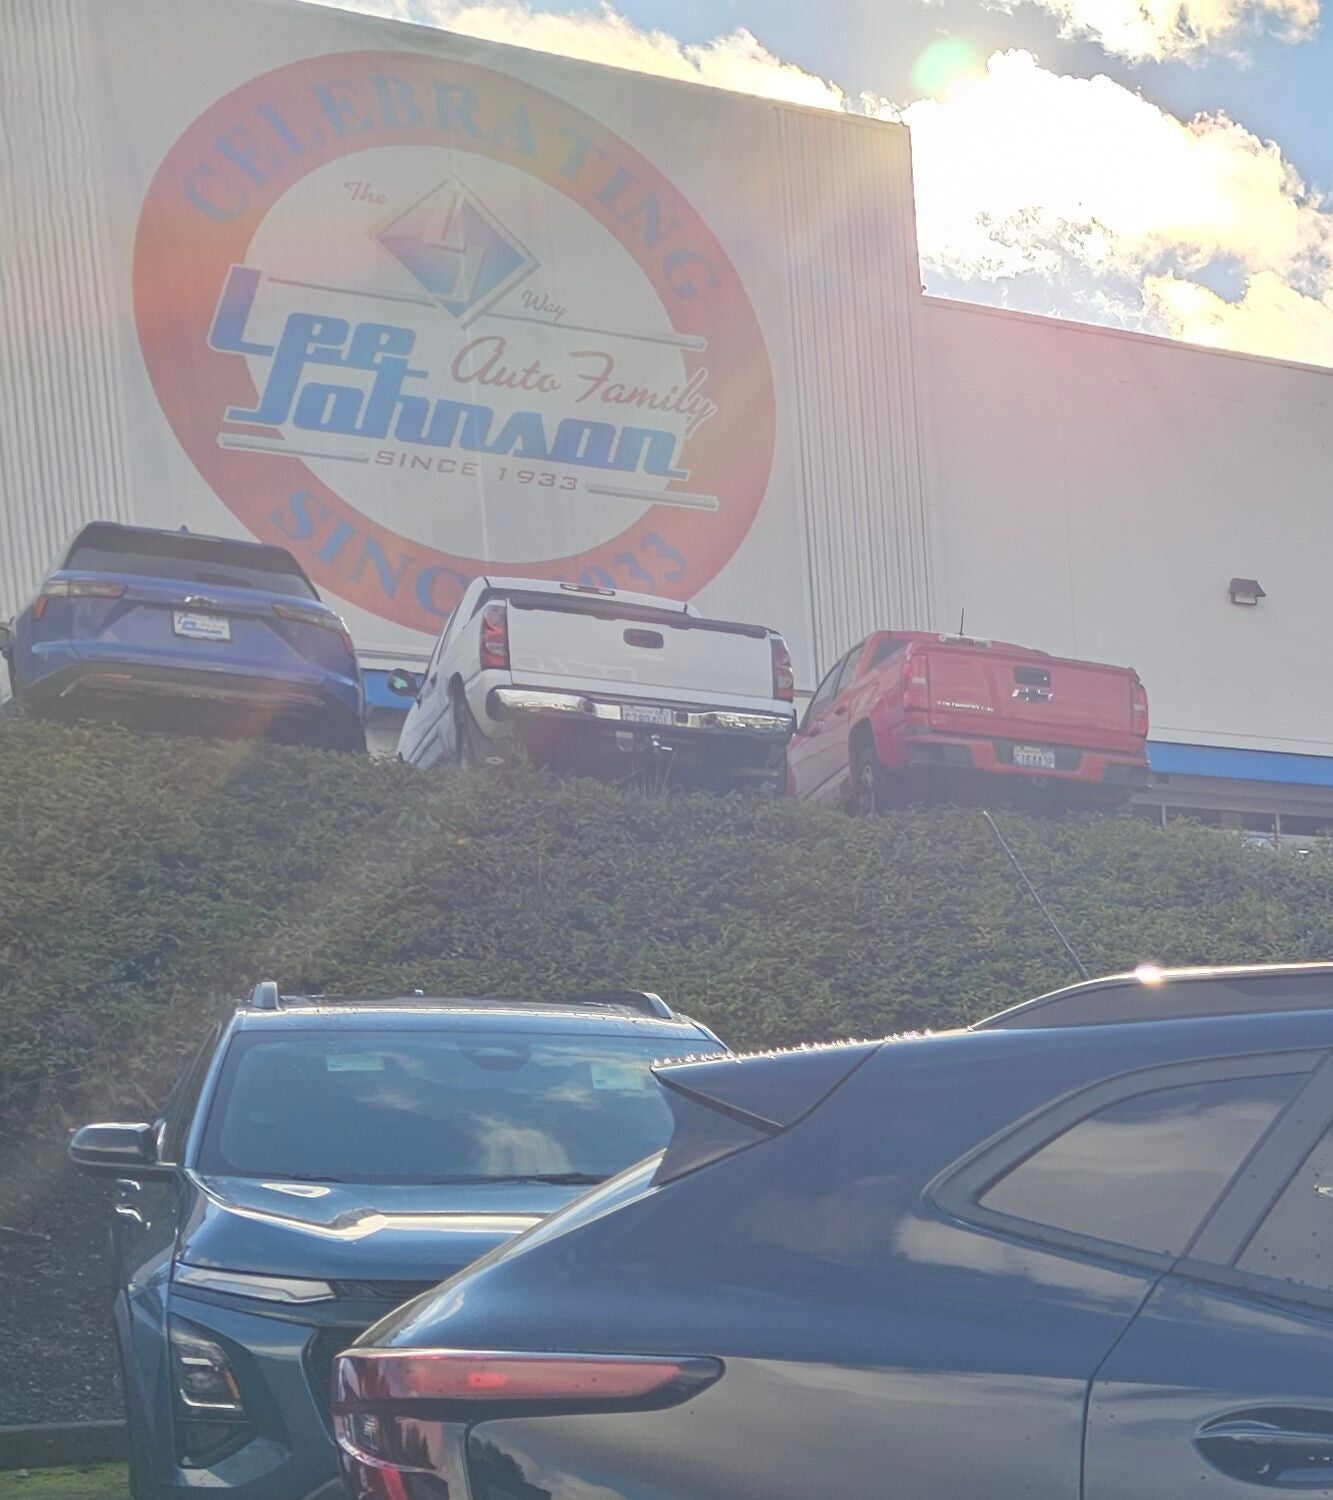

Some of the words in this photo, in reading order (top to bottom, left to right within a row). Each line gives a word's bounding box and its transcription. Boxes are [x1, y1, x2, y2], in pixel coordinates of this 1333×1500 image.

[184, 74, 719, 299] CELEBRATING
[344, 180, 389, 206] The
[209, 265, 416, 372] Lee
[521, 290, 568, 324] Way
[226, 354, 689, 479] Johnson
[451, 335, 562, 393] Auto
[568, 350, 717, 438] Family
[374, 451, 480, 477] SINCE
[499, 467, 579, 491] 1933
[268, 489, 468, 618] SINC
